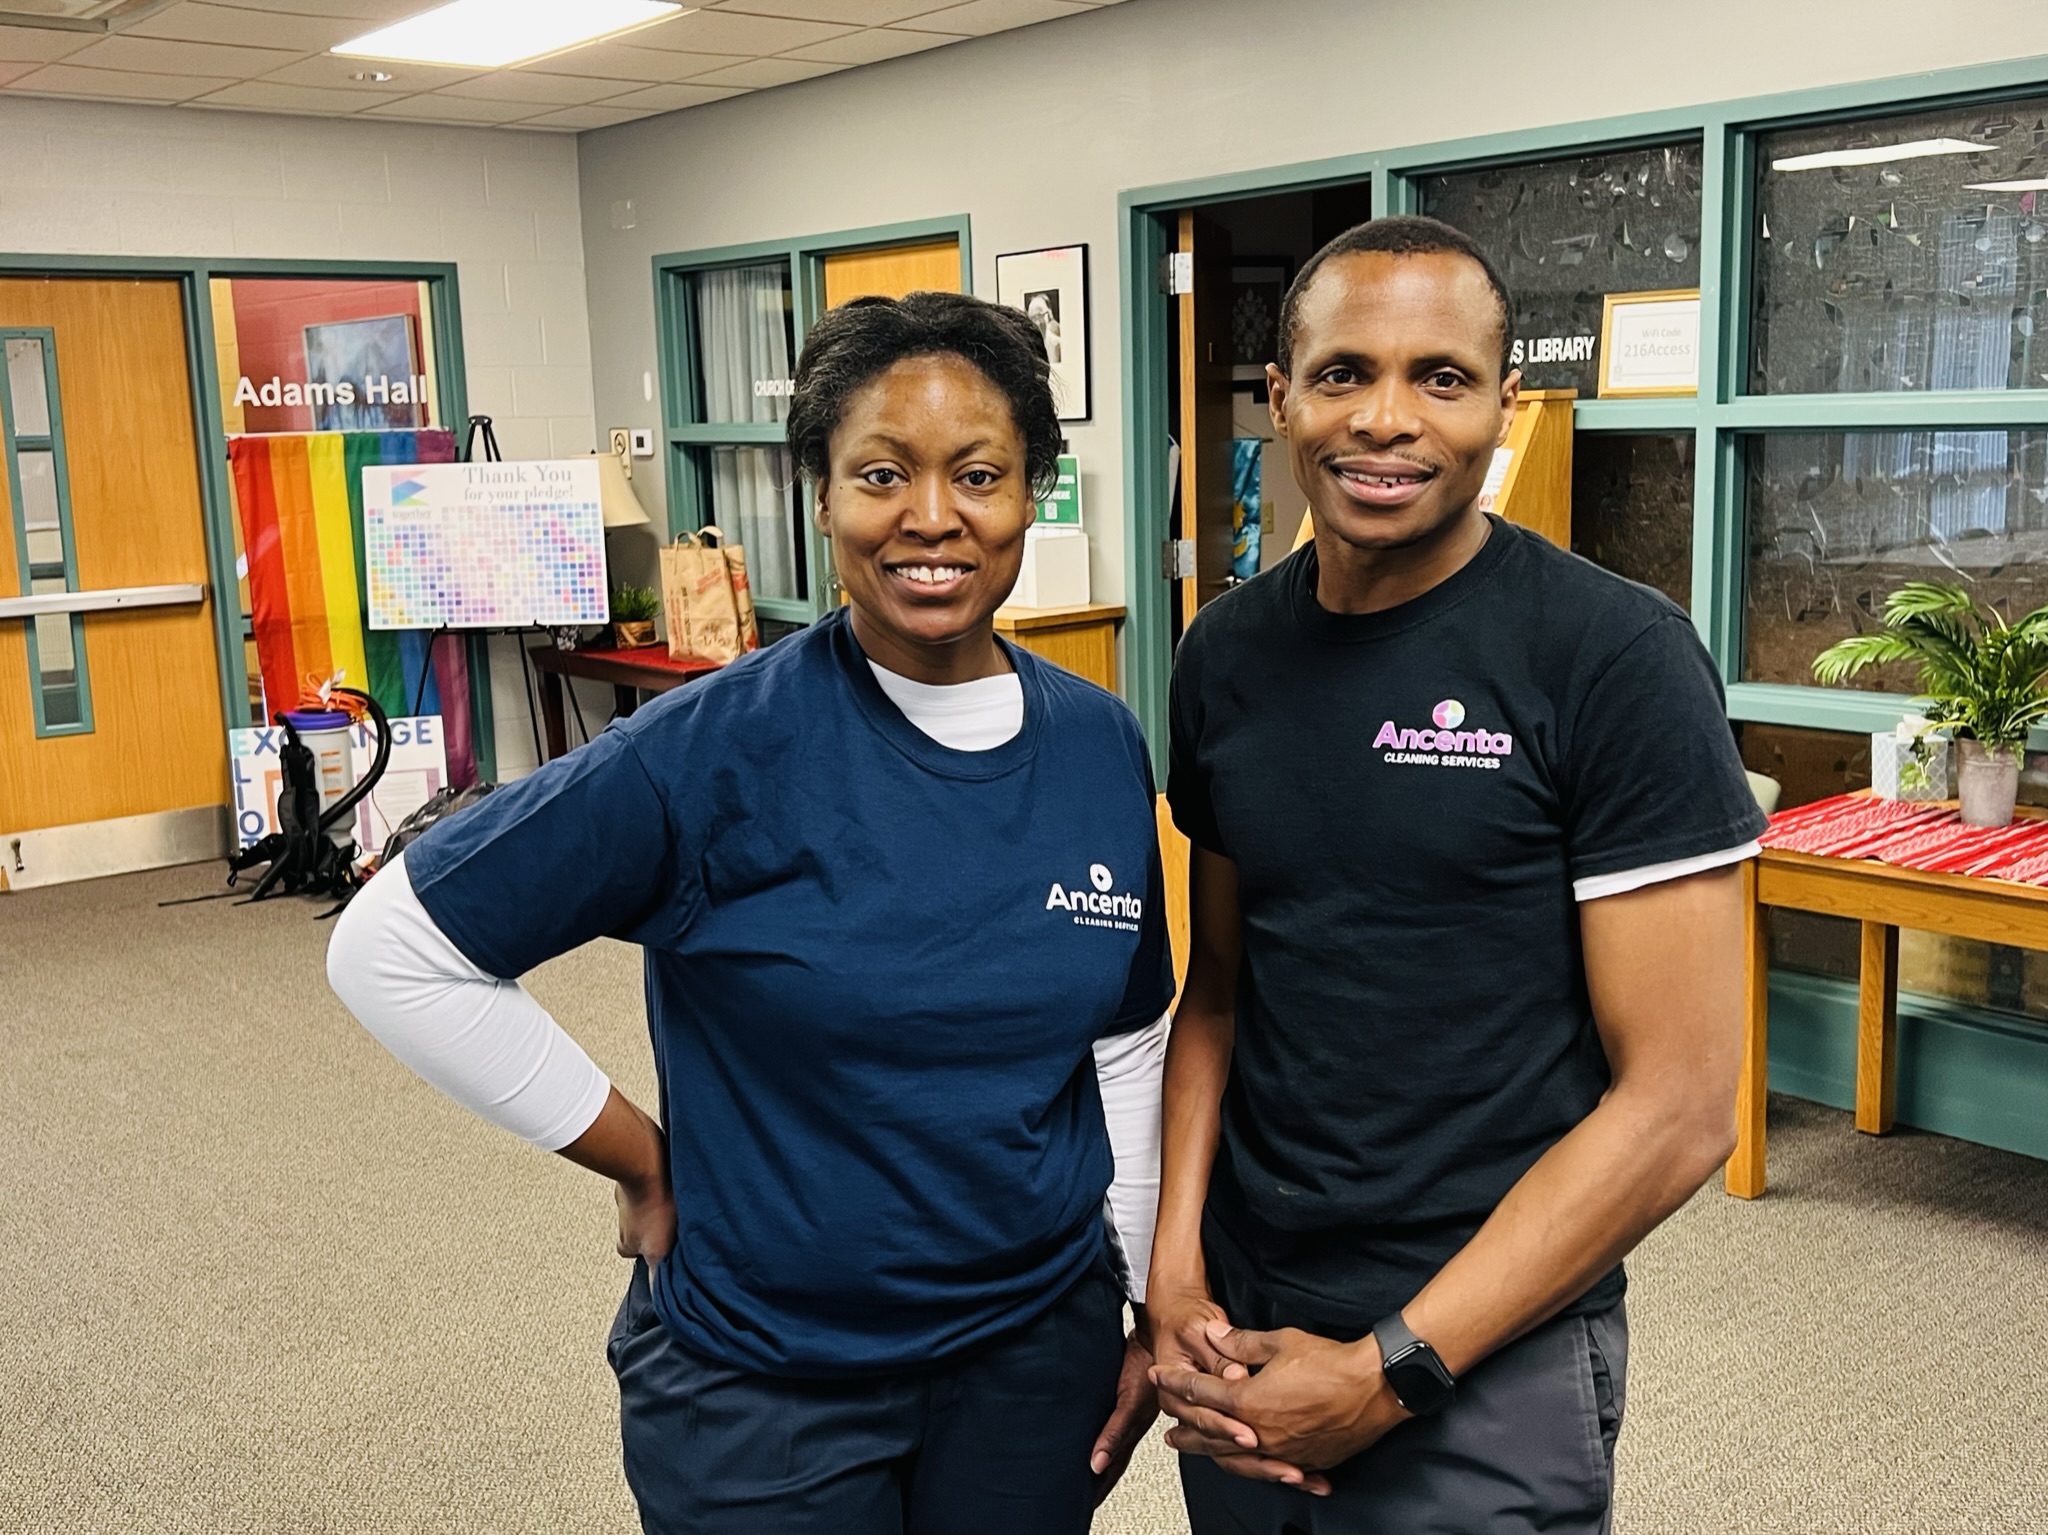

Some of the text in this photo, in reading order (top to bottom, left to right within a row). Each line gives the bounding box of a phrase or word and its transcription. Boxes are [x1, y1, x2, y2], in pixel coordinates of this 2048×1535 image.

[1661, 326, 1682, 338] Code
[1509, 336, 1596, 364] S LIBRARY
[1624, 343, 1692, 358] 216Access
[233, 374, 428, 407] Adams Hall
[754, 379, 785, 397] CHURCH
[463, 464, 572, 484] Thank You
[464, 484, 574, 503] for your pledge!
[392, 508, 432, 521] together
[1372, 721, 1513, 755] Ancenta
[1384, 752, 1500, 769] CLEANING SERVICES
[1046, 883, 1142, 919] Ancenta
[1074, 916, 1113, 928] CLEANING
